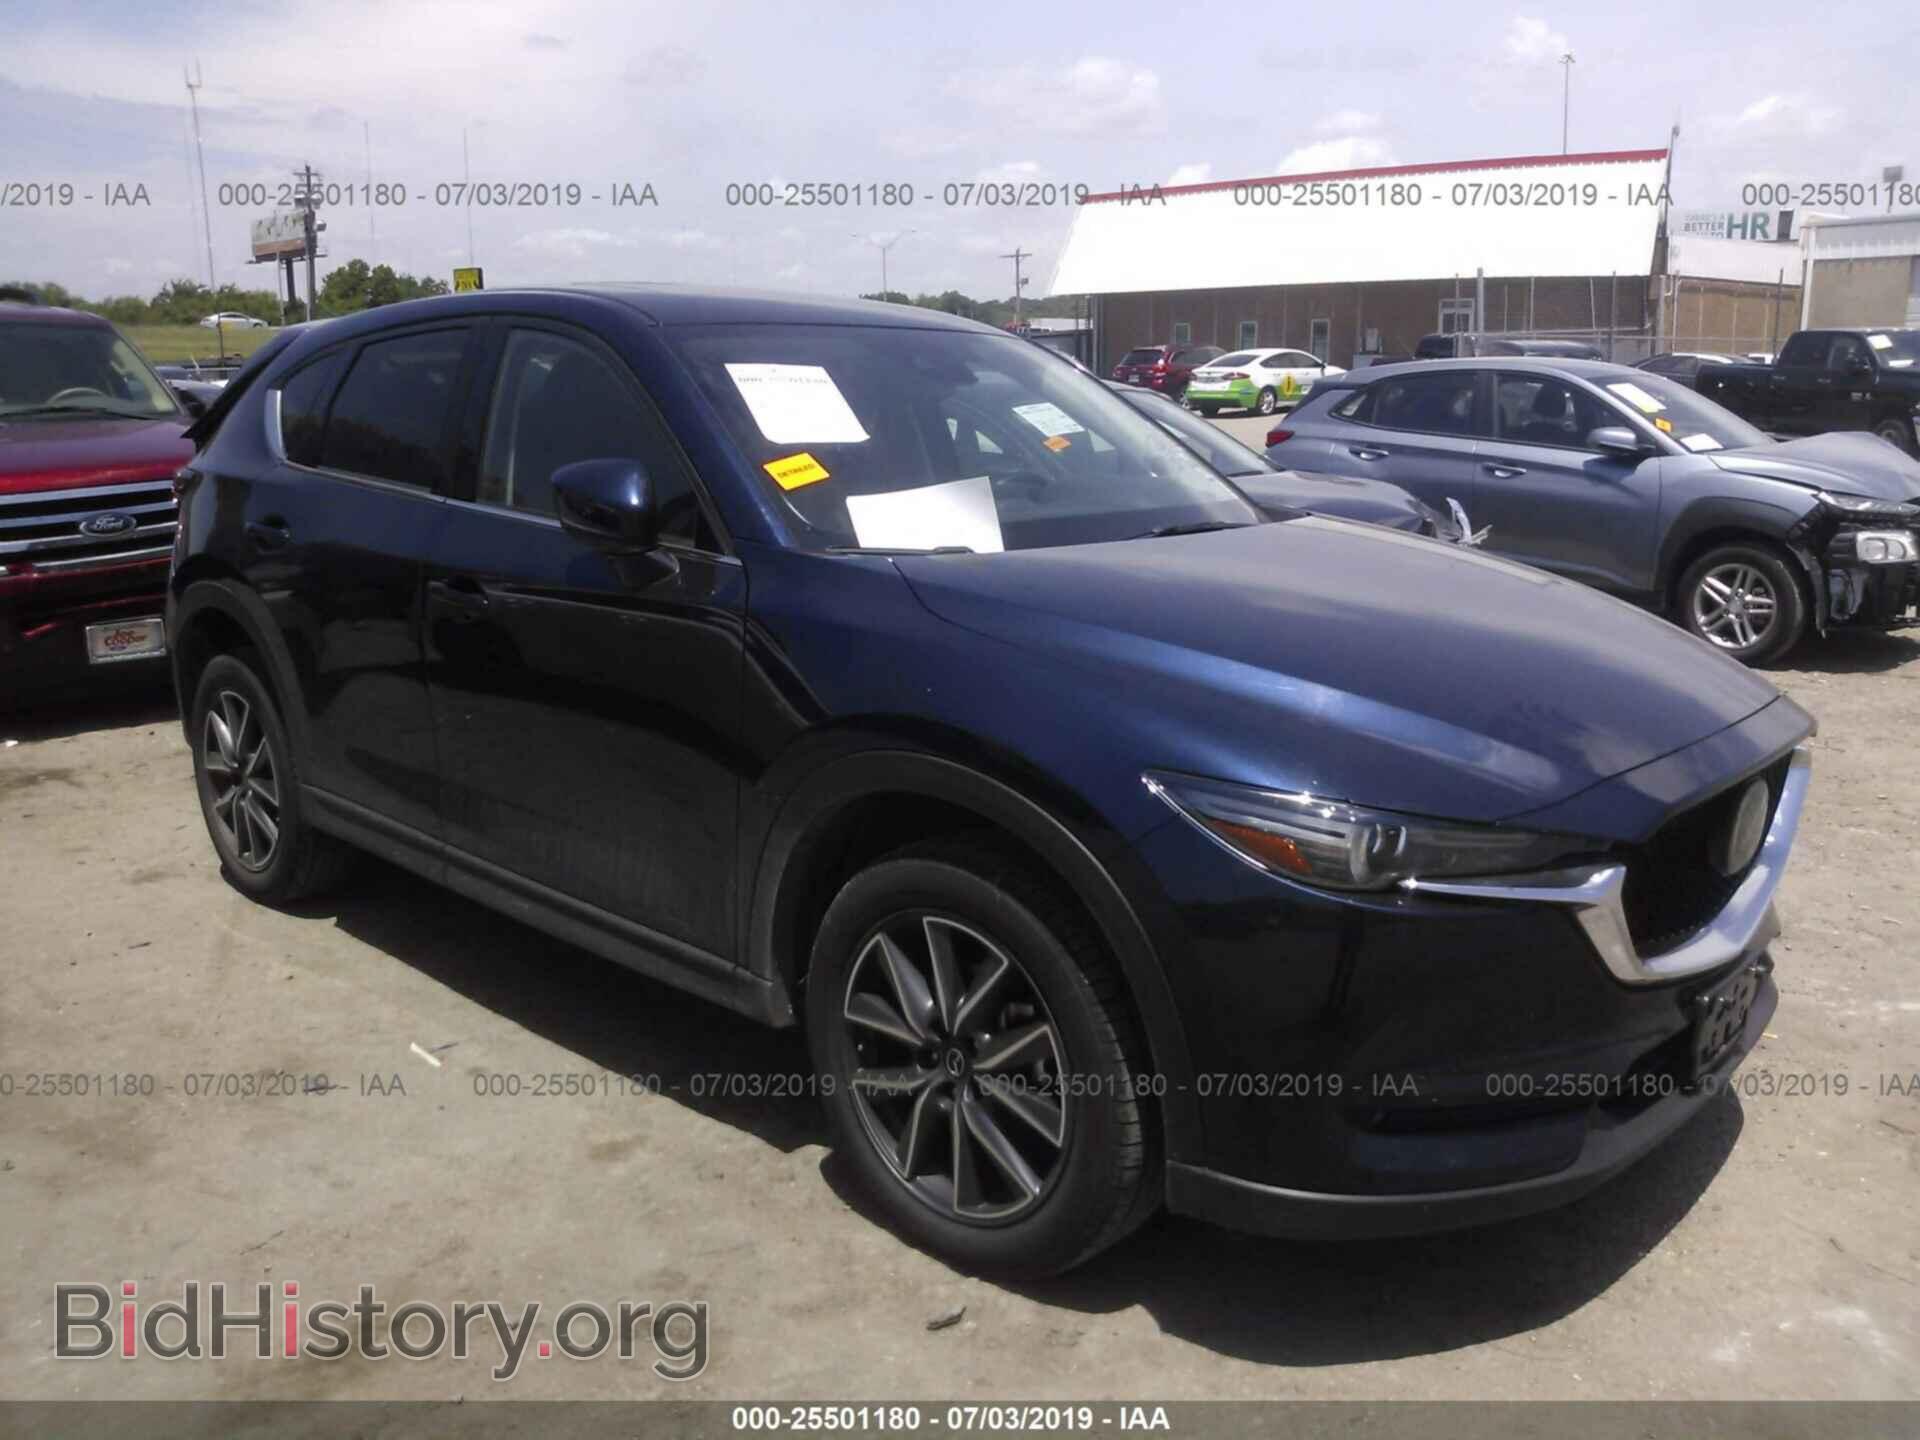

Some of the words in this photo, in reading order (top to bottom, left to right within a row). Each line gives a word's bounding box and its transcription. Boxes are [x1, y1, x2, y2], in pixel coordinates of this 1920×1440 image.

[1684, 222, 1725, 232] BETTER
[1726, 212, 1770, 240] HR
[93, 515, 124, 530] Ford
